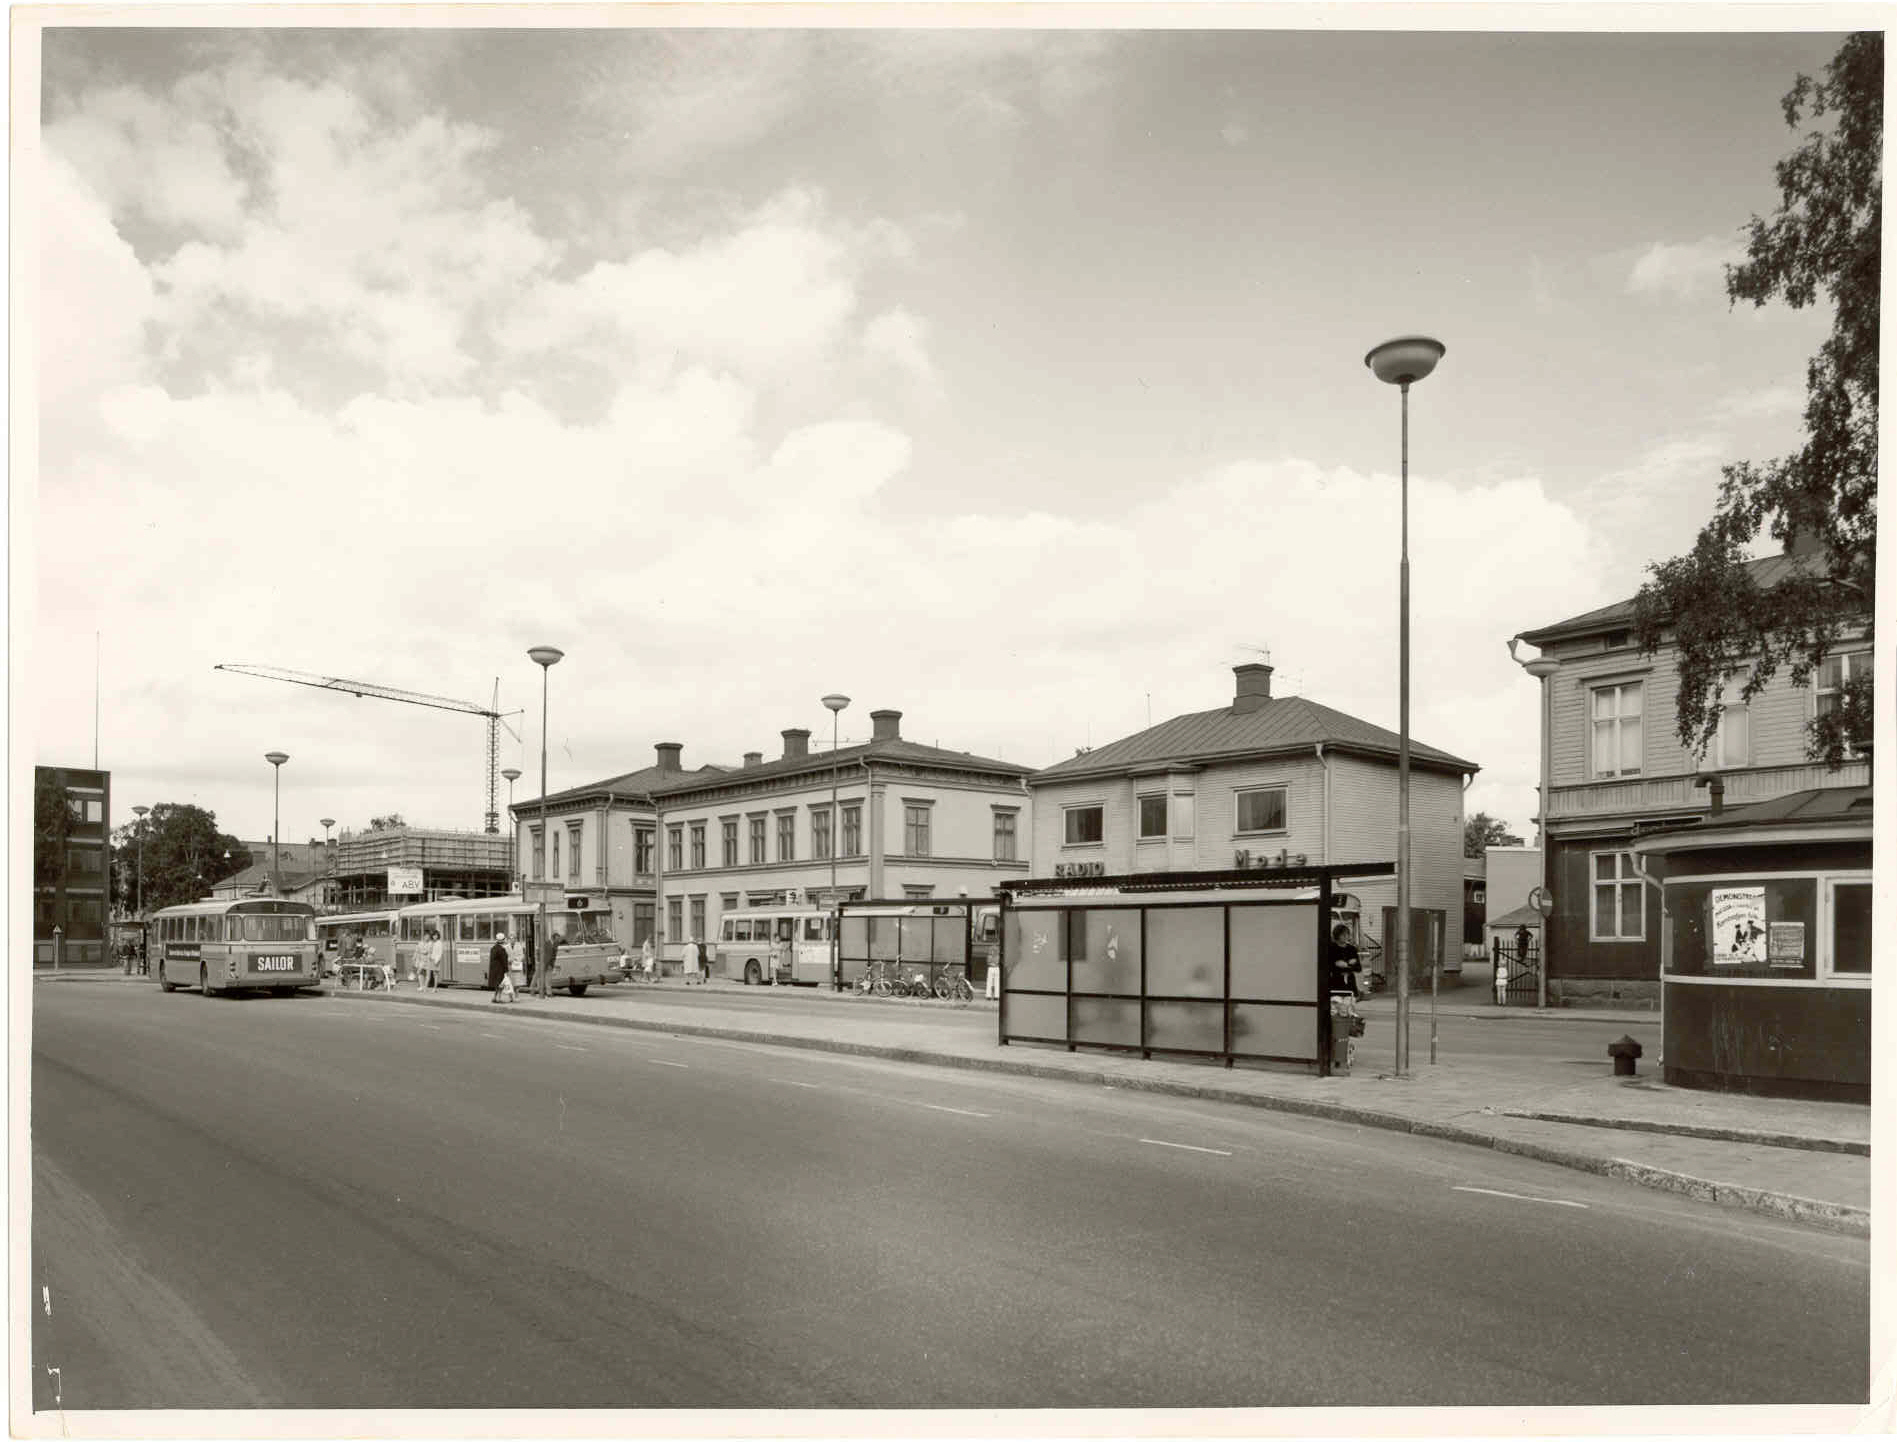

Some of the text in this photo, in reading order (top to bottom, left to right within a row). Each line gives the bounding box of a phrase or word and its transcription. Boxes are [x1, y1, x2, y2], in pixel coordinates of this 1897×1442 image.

[1234, 848, 1307, 868] Mode
[1055, 860, 1104, 877] RADIO
[257, 956, 294, 971] SAILOR
